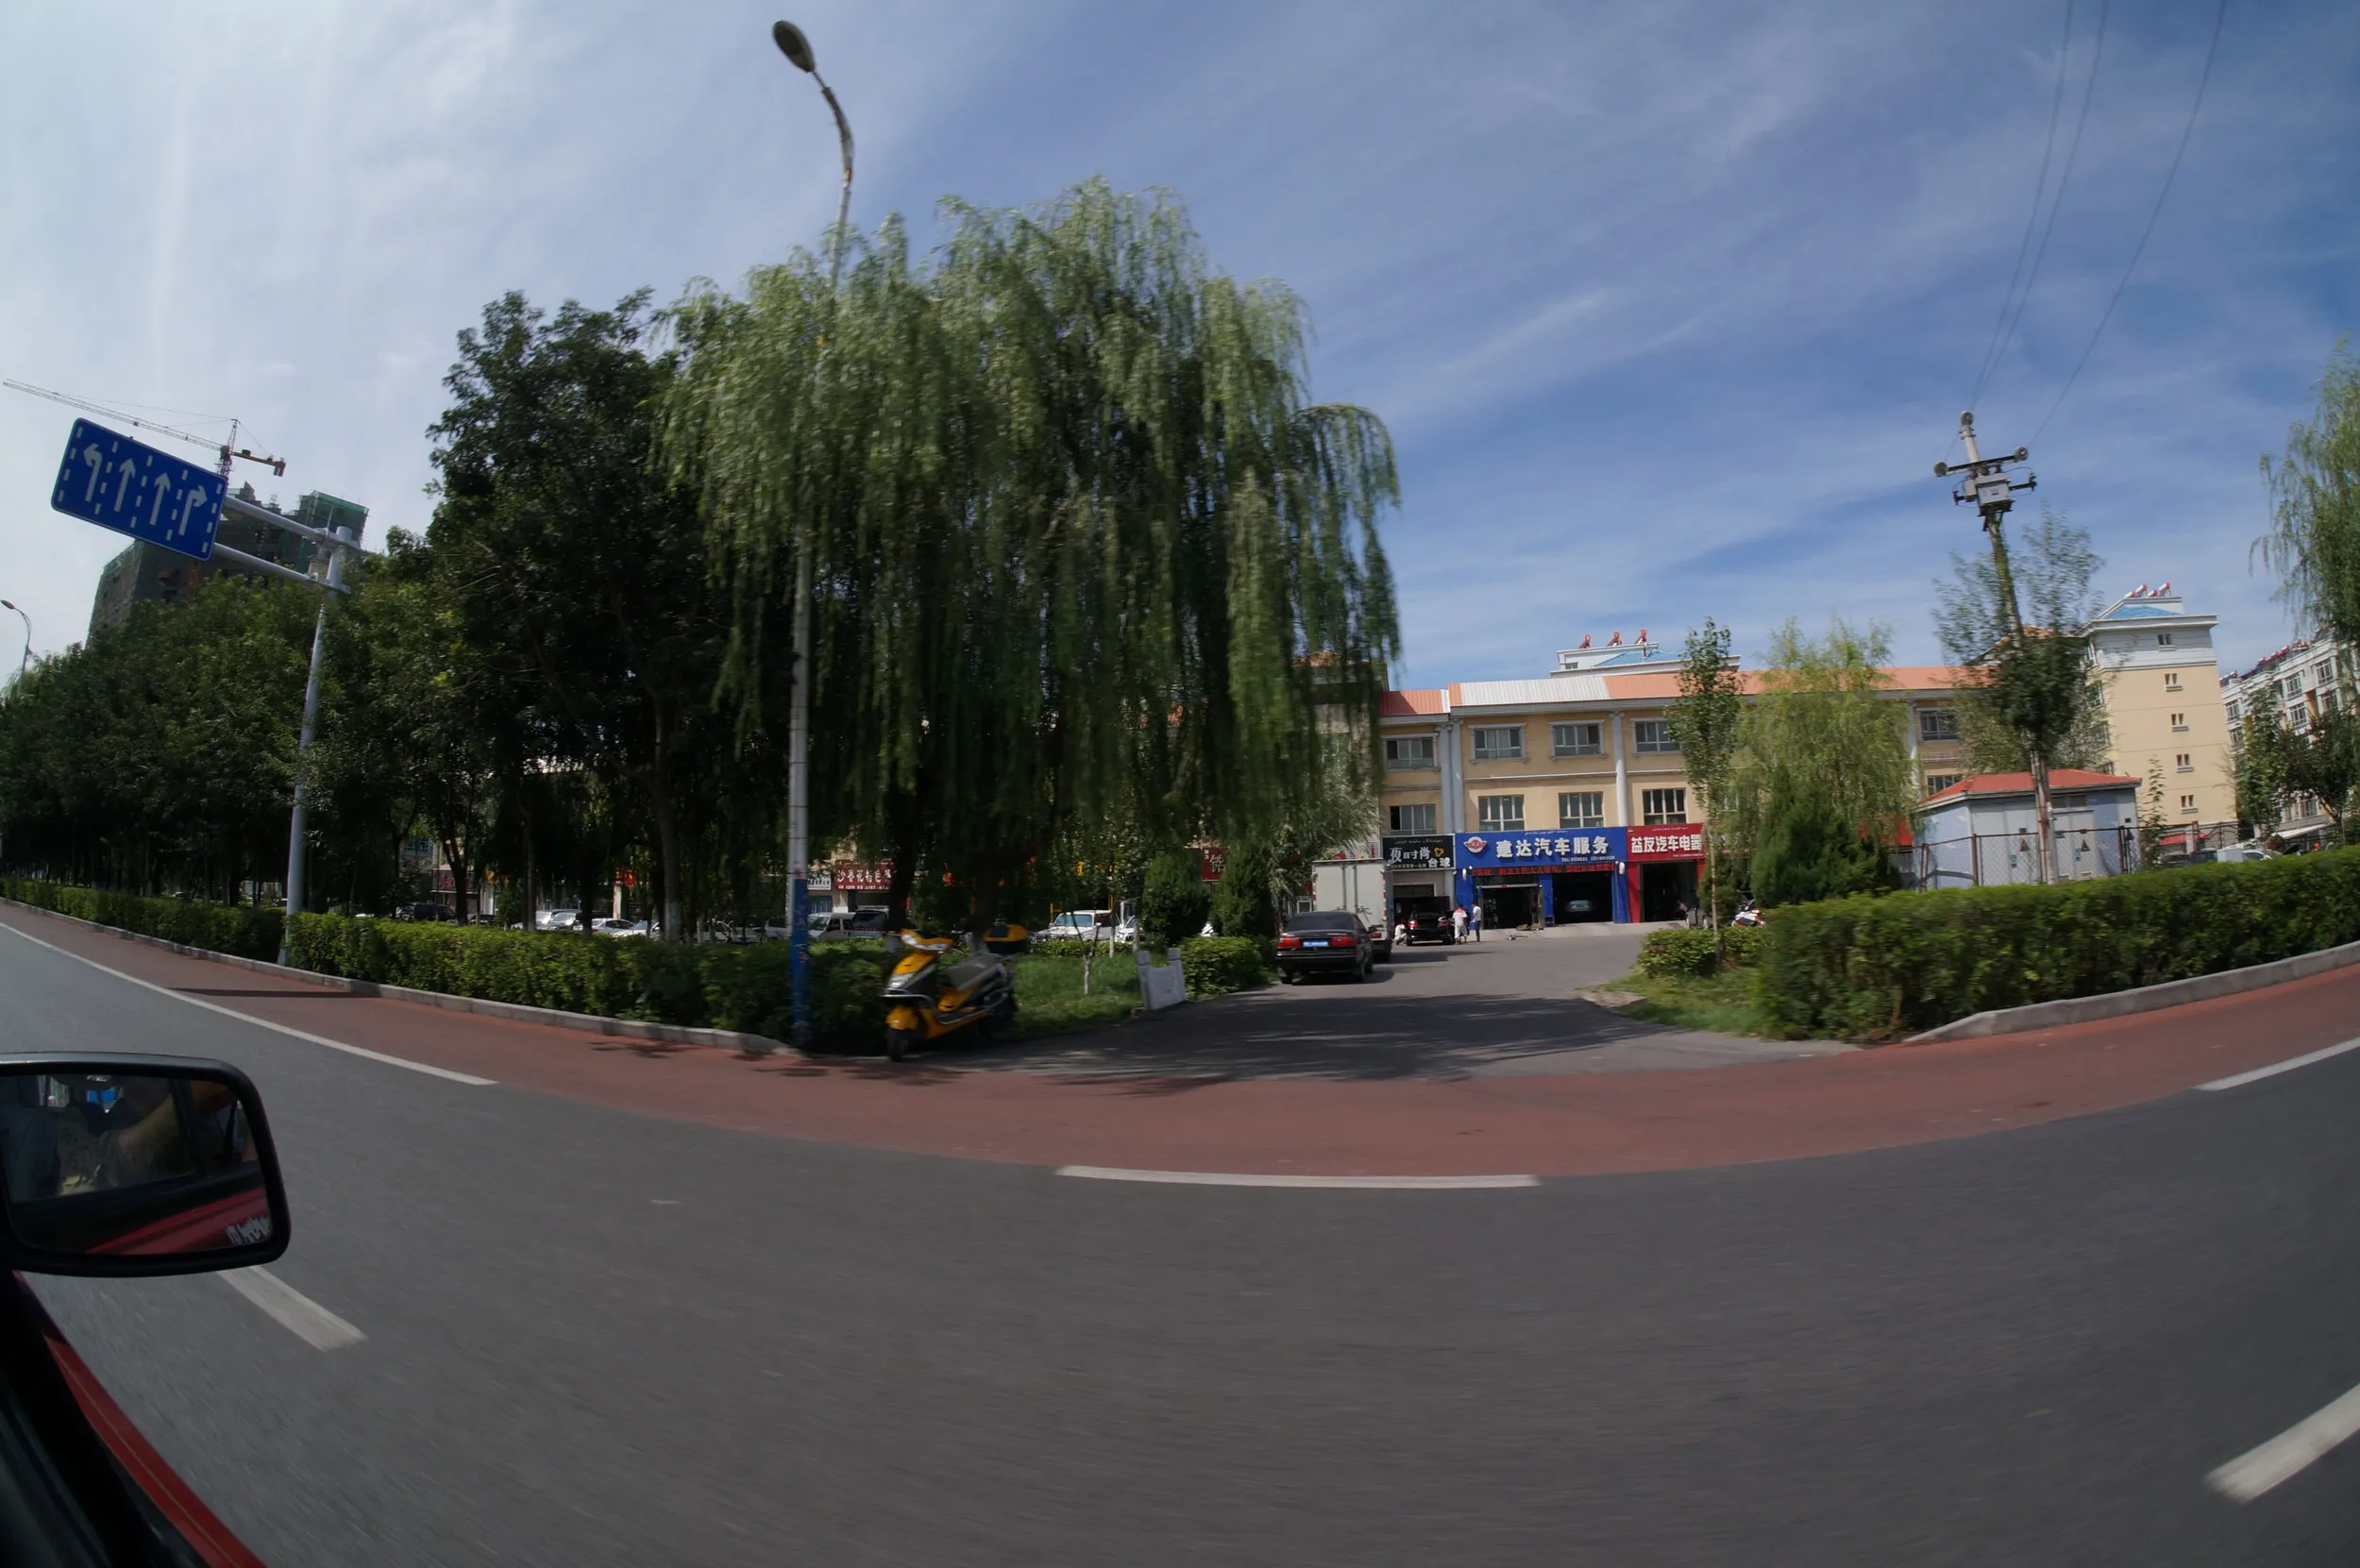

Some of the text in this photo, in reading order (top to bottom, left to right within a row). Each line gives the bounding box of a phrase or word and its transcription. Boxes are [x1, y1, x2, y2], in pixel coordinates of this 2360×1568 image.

[1495, 836, 1609, 858] 建达汽车服务
[1428, 857, 1451, 868] 台球
